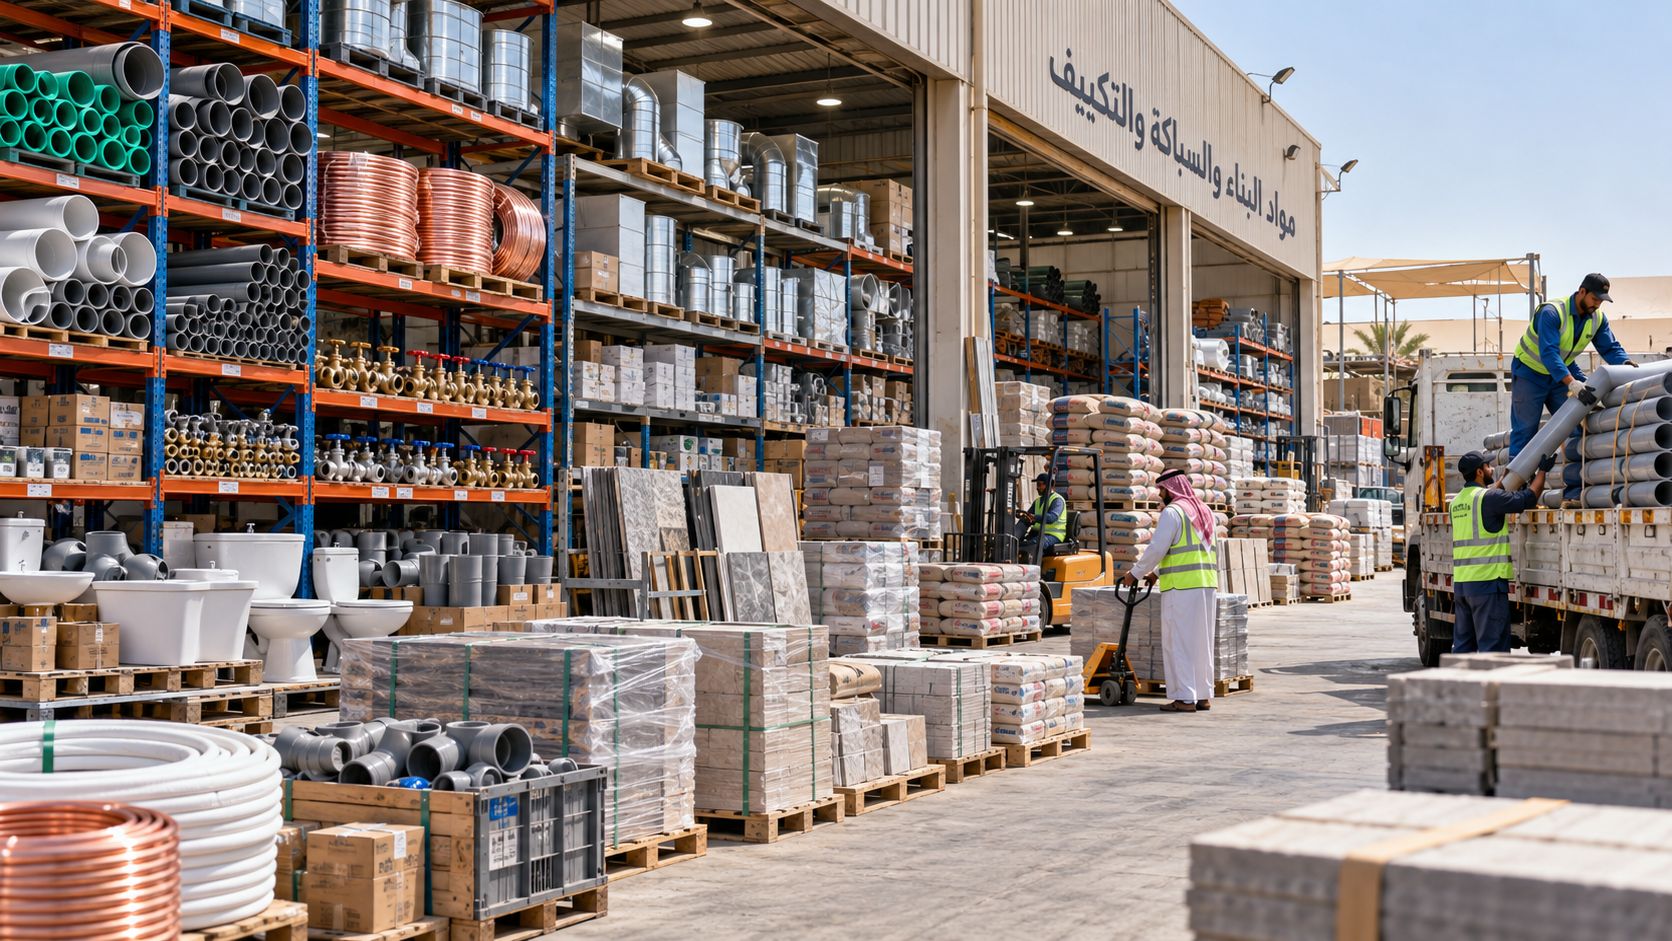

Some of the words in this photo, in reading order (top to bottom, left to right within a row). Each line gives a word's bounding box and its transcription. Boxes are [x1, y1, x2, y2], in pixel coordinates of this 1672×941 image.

[1049, 48, 1145, 151] والتكييف
[1150, 107, 1222, 199] والسباكة
[1225, 162, 1262, 220] البناء
[1266, 190, 1296, 241] مواد
